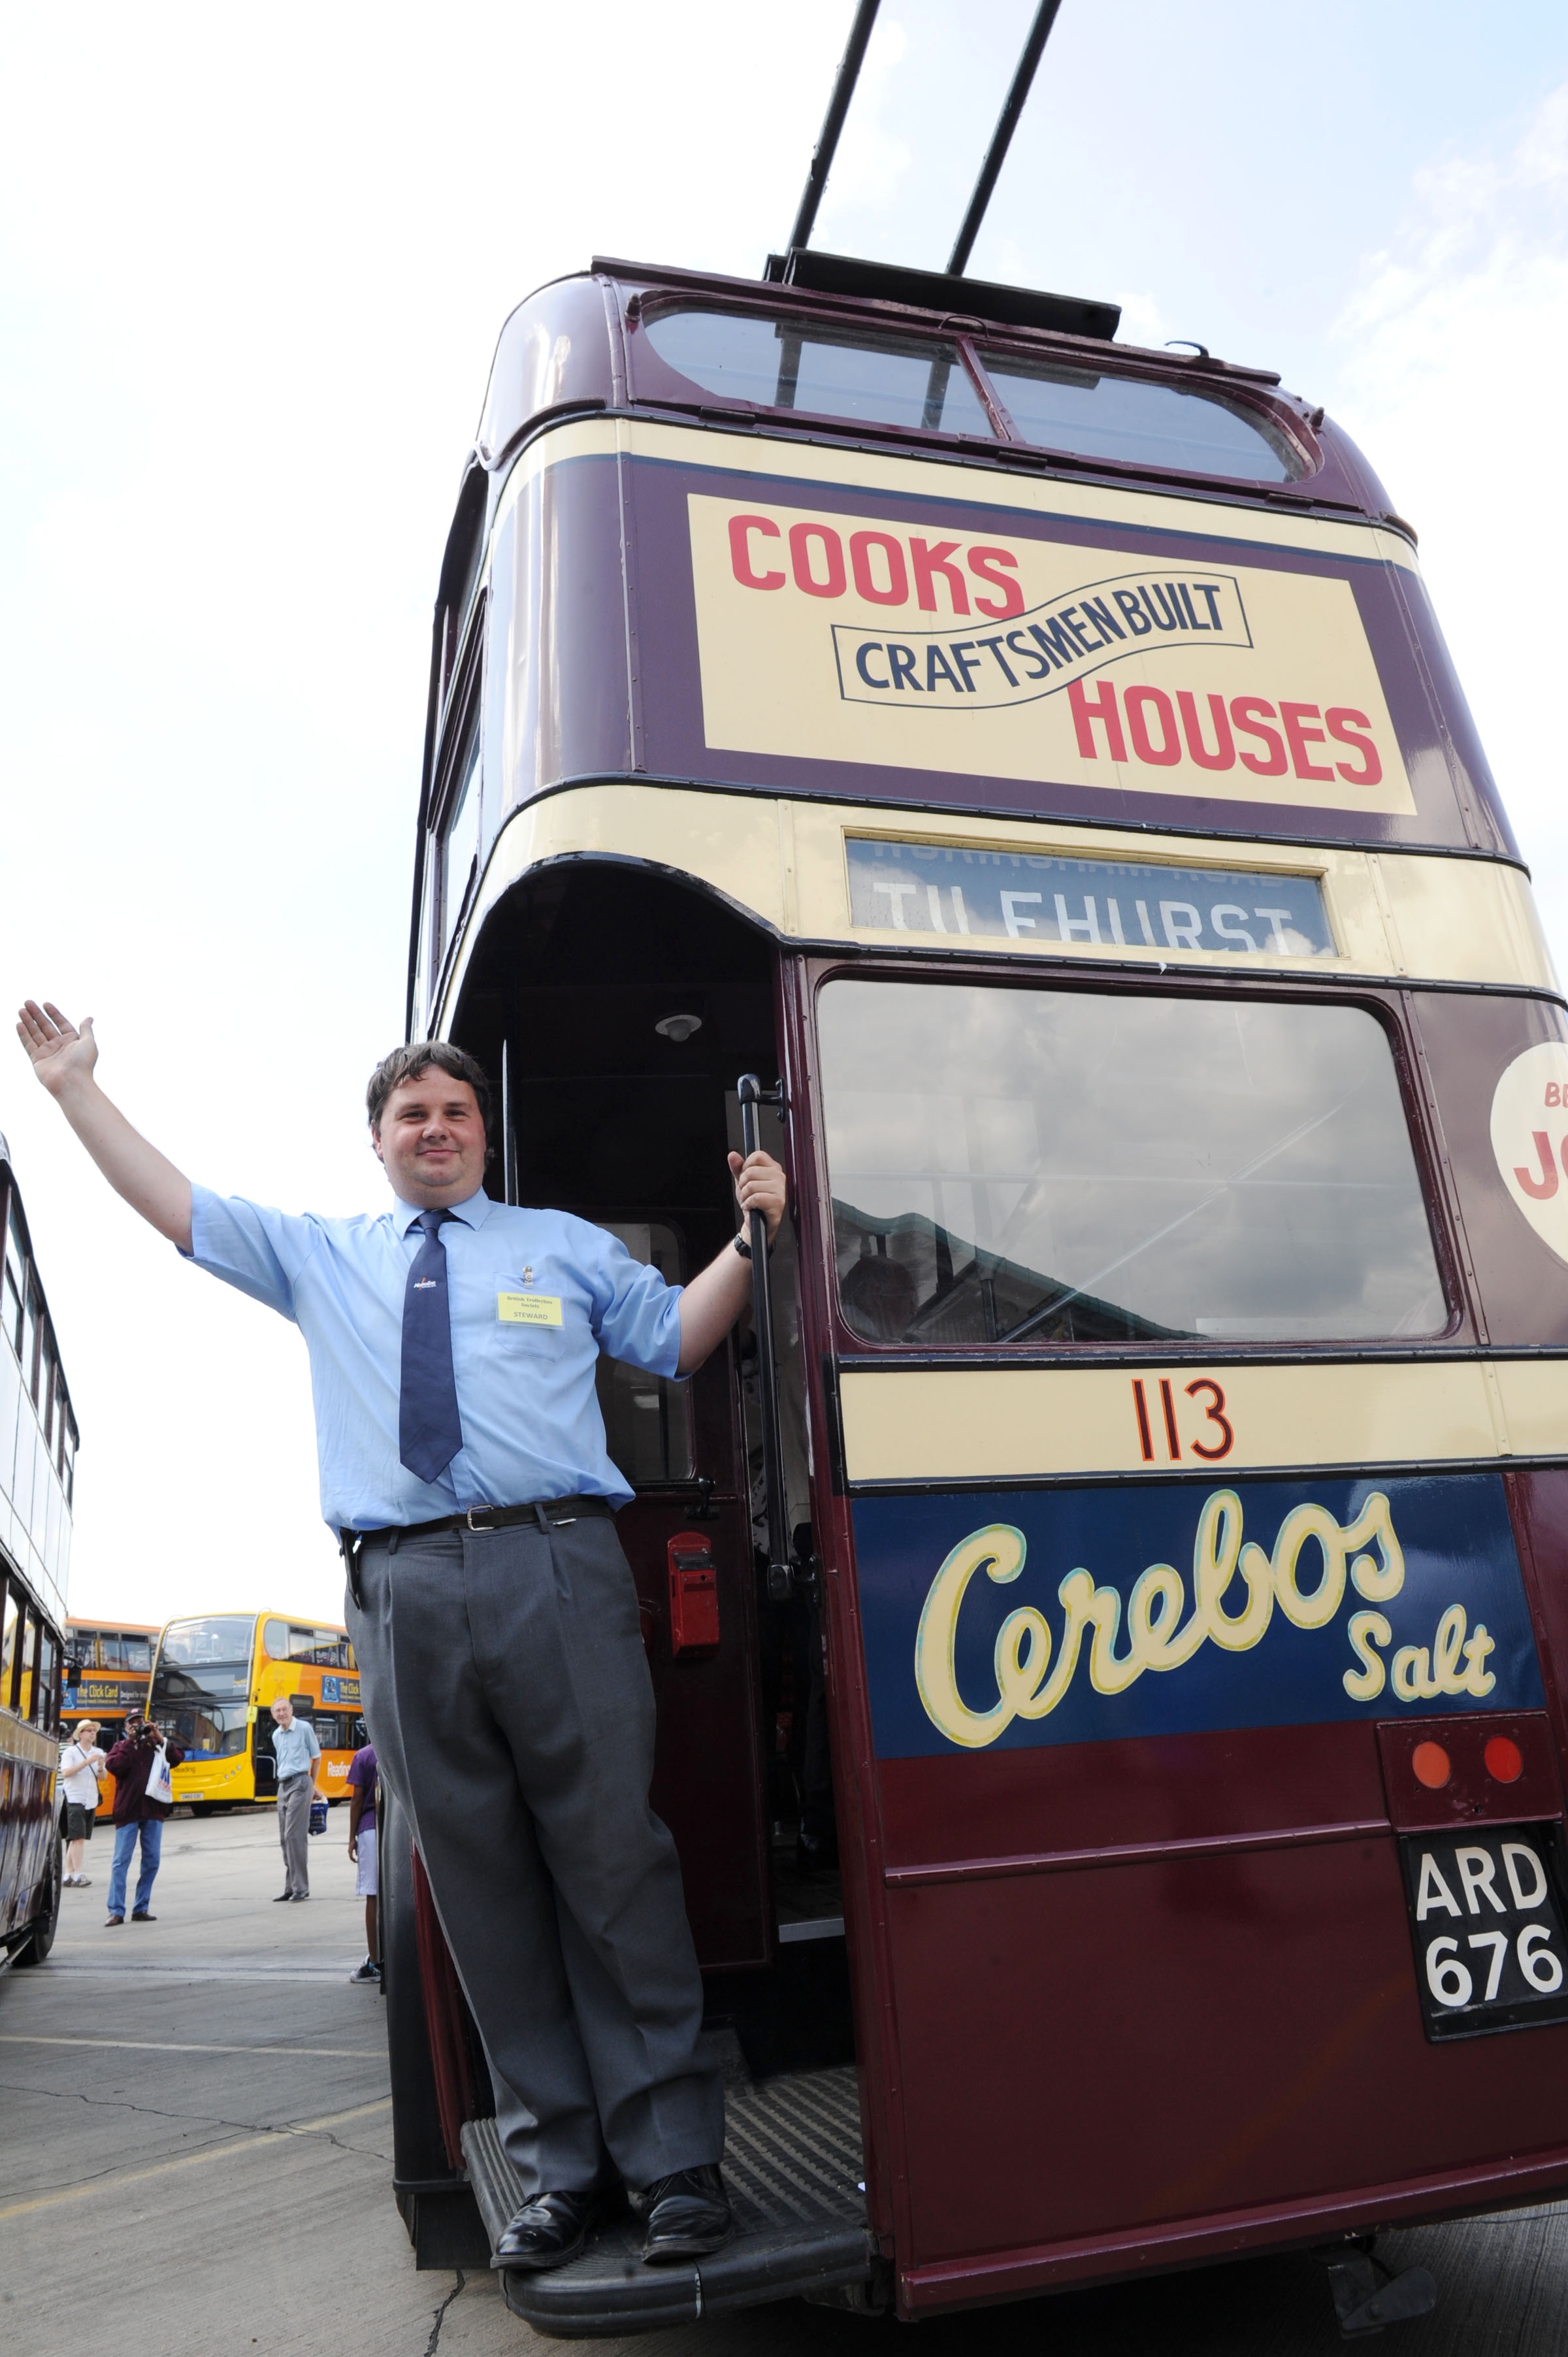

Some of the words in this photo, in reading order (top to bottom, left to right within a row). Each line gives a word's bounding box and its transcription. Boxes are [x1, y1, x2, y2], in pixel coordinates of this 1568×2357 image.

[728, 515, 1025, 619] COOKS
[857, 596, 1128, 692] CRAFTSMEN
[1112, 583, 1224, 636] BUILT
[1068, 679, 1382, 785] HOUSES
[514, 1311, 548, 1321] STEWARD
[1130, 1376, 1235, 1462] 113
[89, 1684, 103, 1698] Click
[105, 1685, 118, 1698] Card
[1343, 1604, 1496, 1702] Salt
[1416, 1843, 1547, 1921] ARD
[1426, 1924, 1563, 2007] 676
